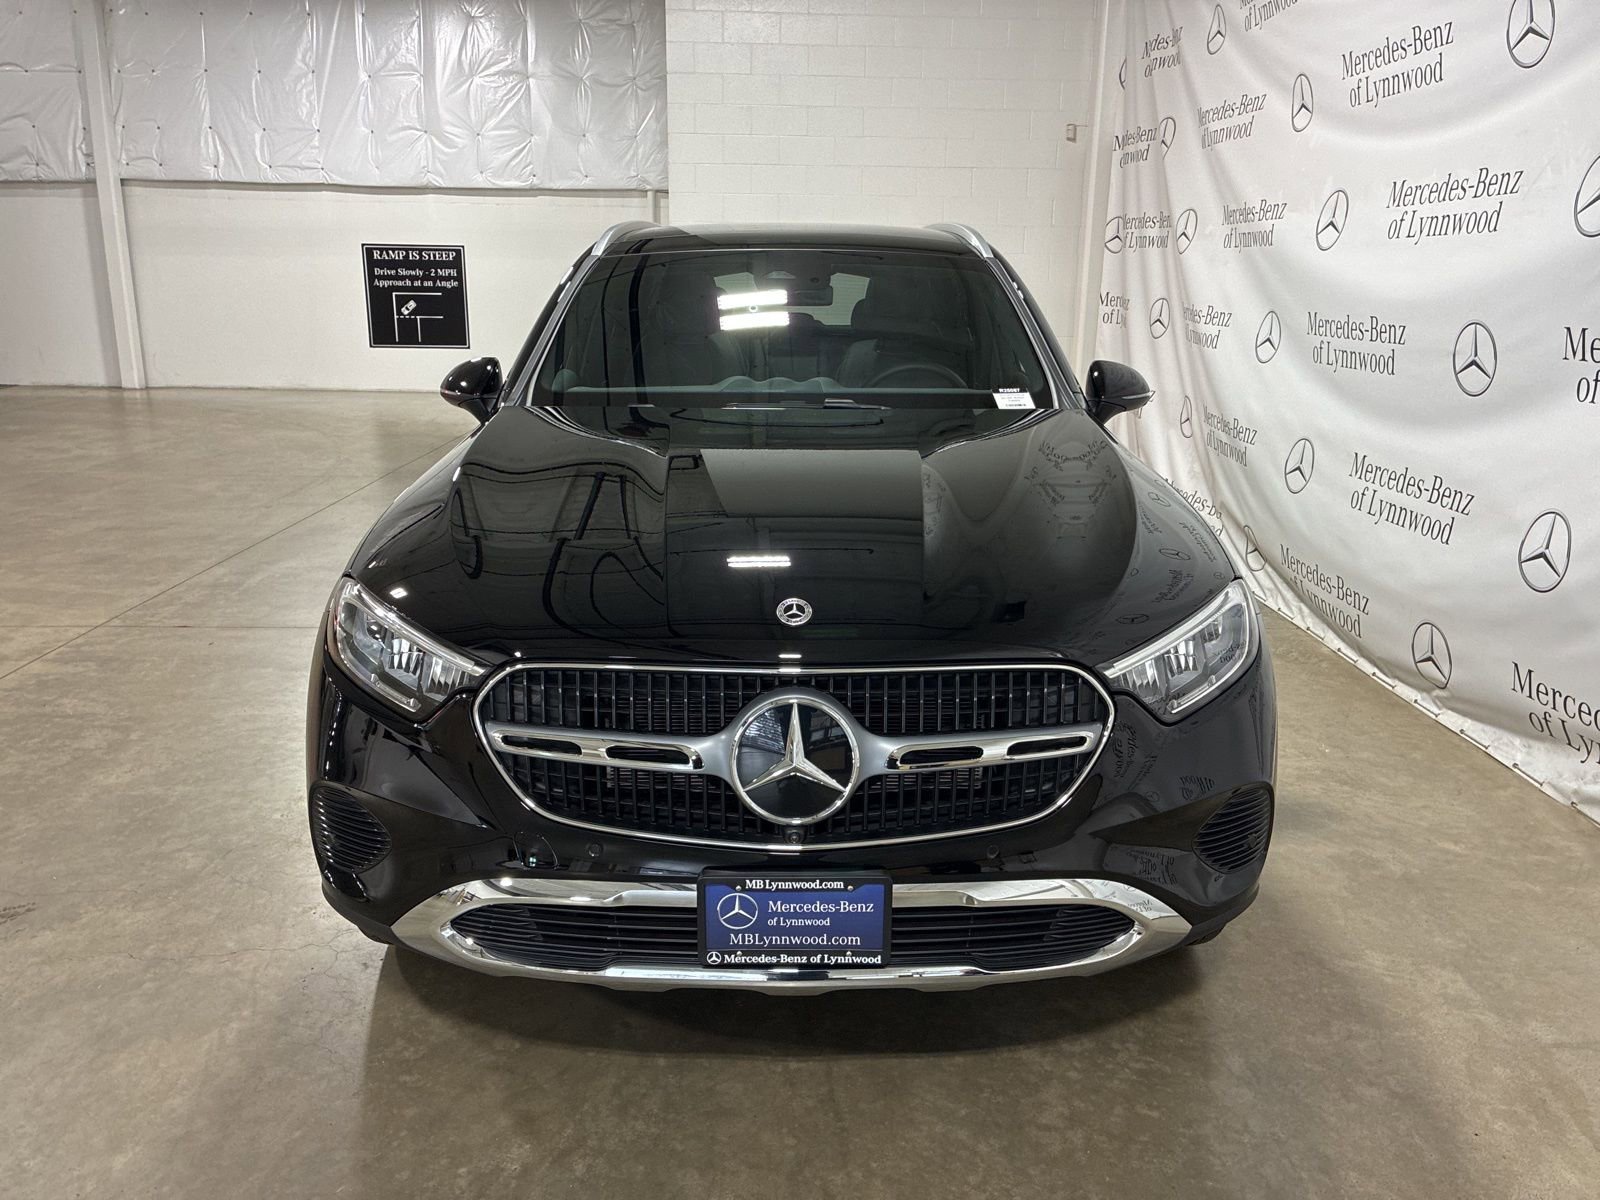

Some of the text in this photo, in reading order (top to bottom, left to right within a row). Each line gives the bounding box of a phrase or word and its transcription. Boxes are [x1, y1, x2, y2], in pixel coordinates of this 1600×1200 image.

[1253, 0, 1297, 30] Lynnwoo
[1341, 21, 1454, 81] Mercedes-Benz
[1349, 52, 1444, 108] of Lynnwood
[1386, 167, 1525, 209] Mercedes-Benz
[1222, 199, 1287, 226] Mercedes-Benz
[1387, 202, 1503, 246] of Lynnwood
[1224, 224, 1274, 253] of Lynnwood
[373, 250, 456, 261] RAMP IS STEEP
[373, 279, 412, 288] Approach
[435, 280, 459, 289] Angle
[374, 268, 396, 276] Drive
[397, 268, 424, 278] Slowly
[437, 269, 457, 277] MPH
[1307, 311, 1407, 346] Mercedes-Benz
[1312, 340, 1396, 376] of Lynnwood
[1349, 452, 1475, 516] Mercedes-Benz
[1350, 486, 1455, 545] of Lynnwood
[1280, 543, 1369, 616] Mercedes-Benz
[1529, 711, 1556, 739] of
[768, 901, 874, 912] Mercedes-Benz
[768, 917, 830, 928] of Lynnwood
[729, 933, 861, 947] MBLynnwood.com
[724, 954, 882, 965] Mercedes-Benz of Lynnwood
